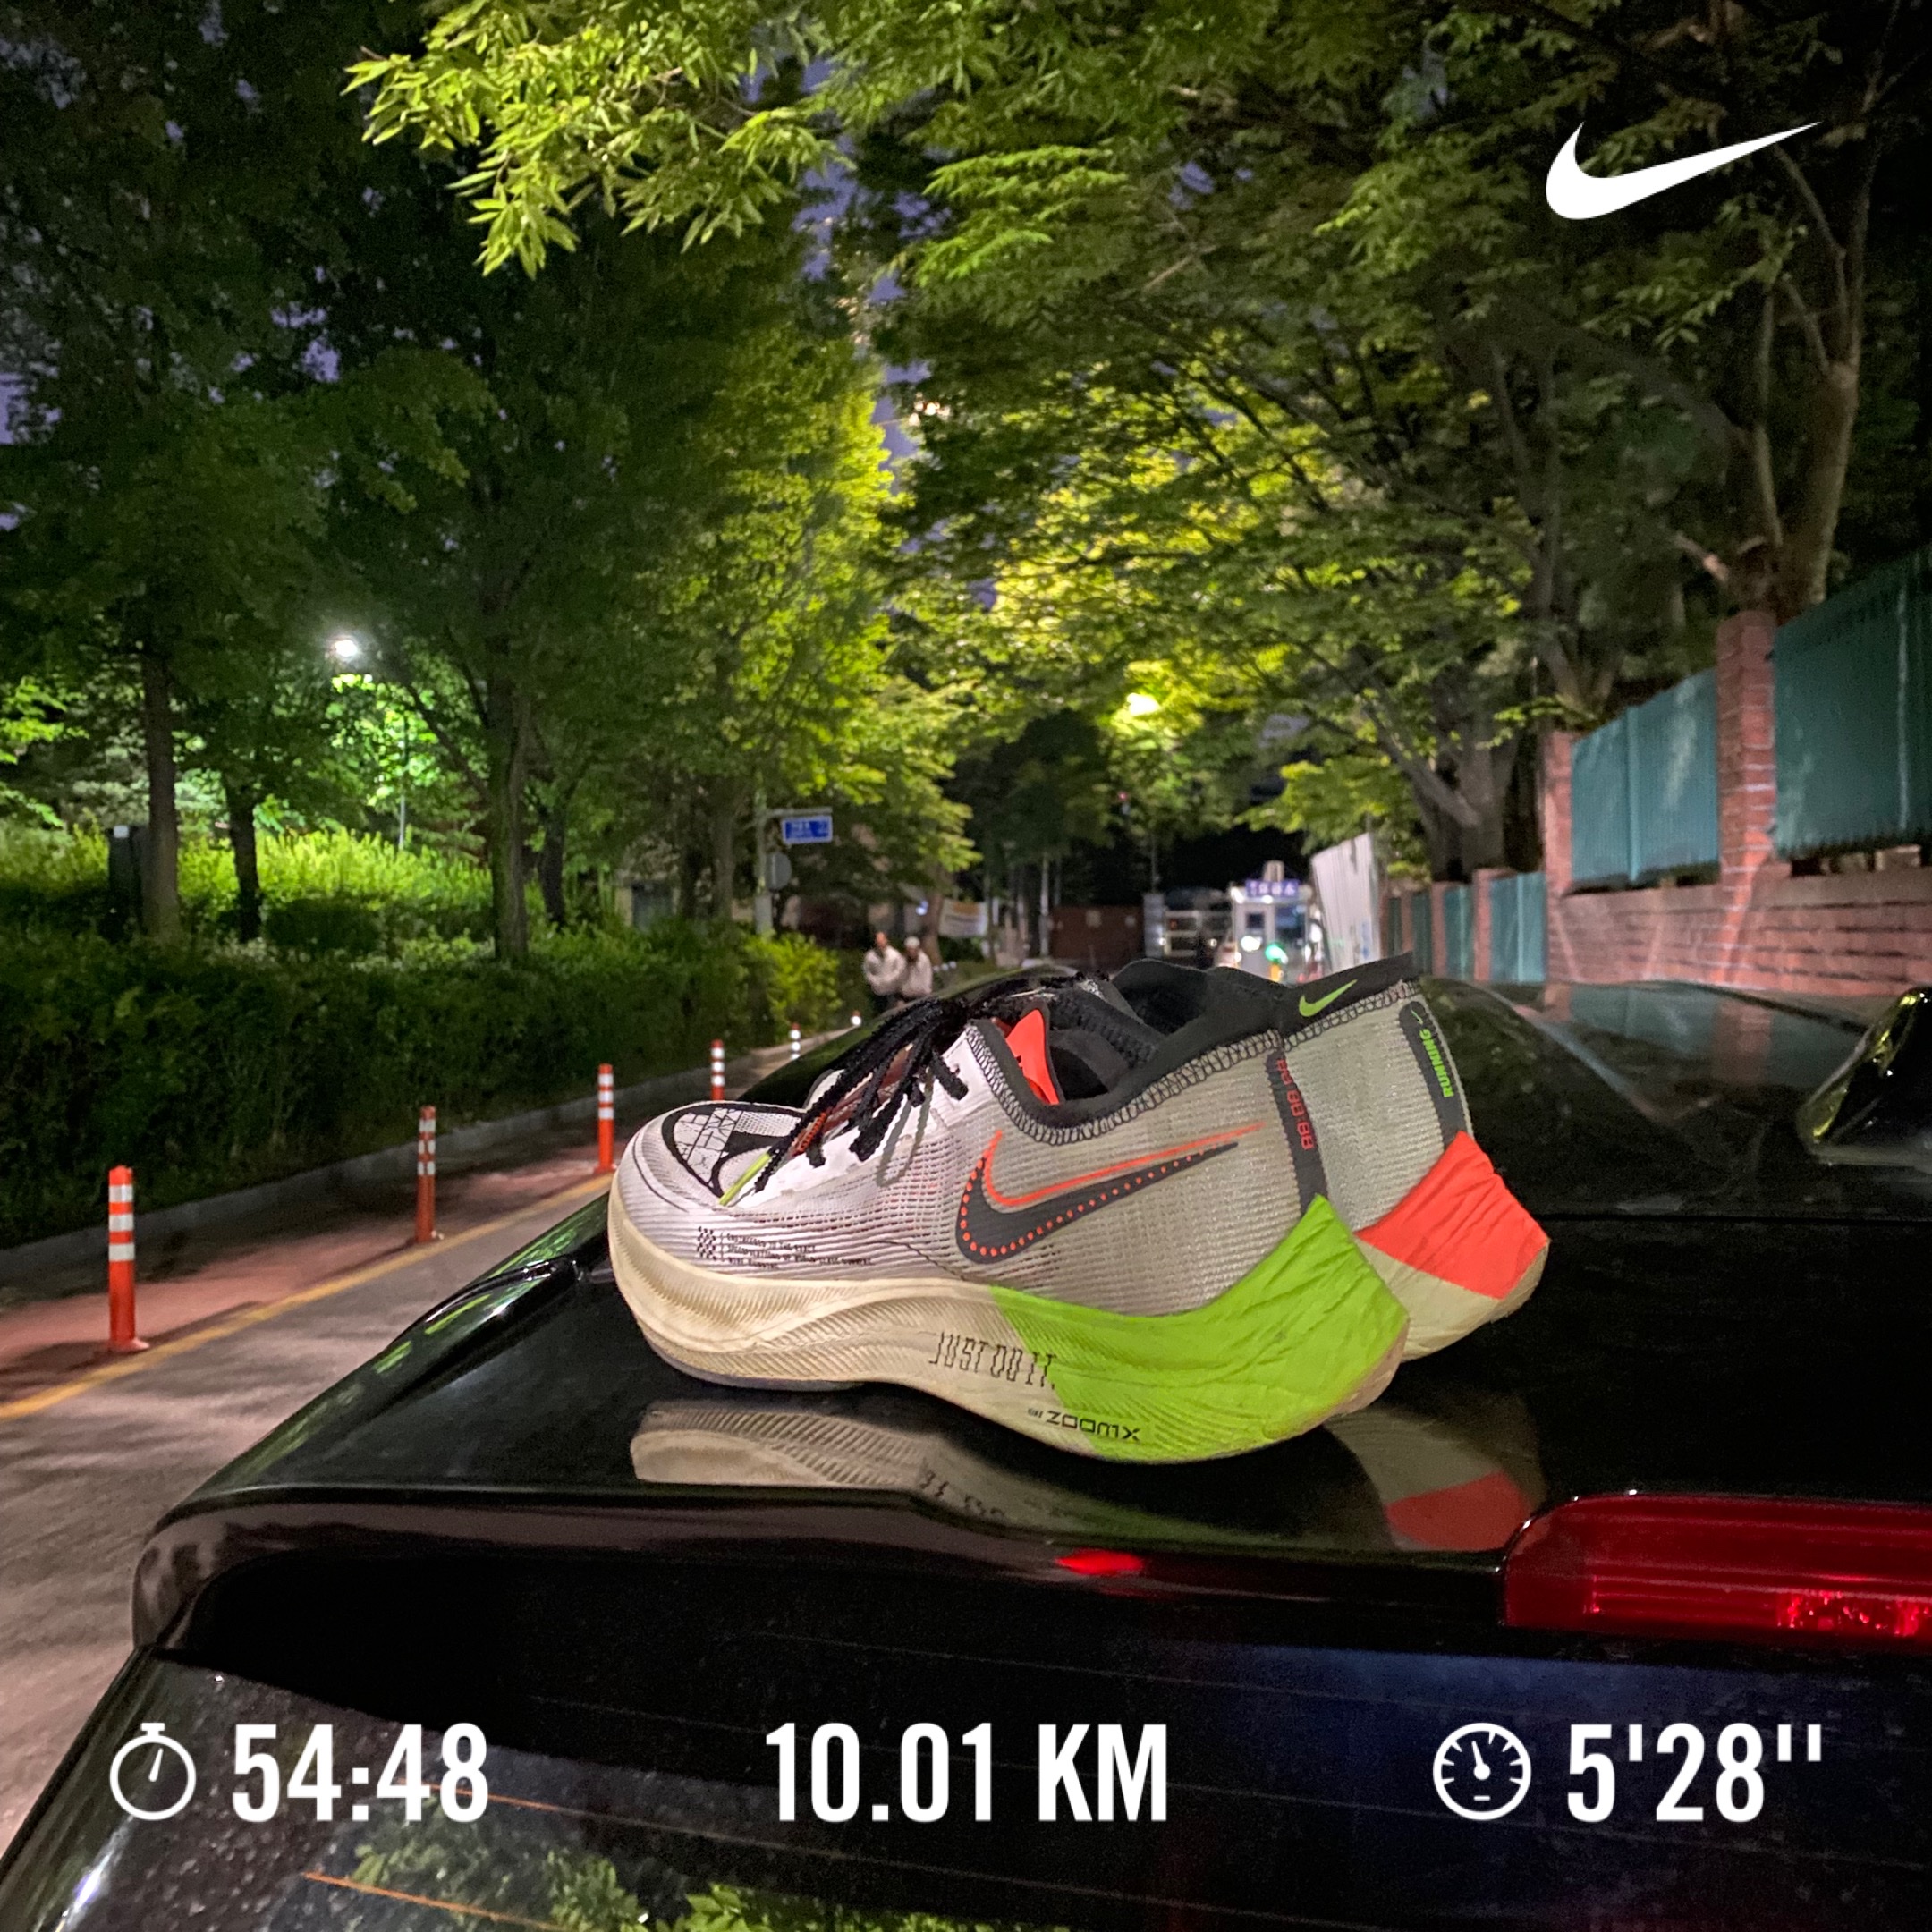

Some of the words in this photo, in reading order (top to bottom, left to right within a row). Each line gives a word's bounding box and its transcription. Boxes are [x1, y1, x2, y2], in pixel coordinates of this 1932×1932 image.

[1419, 1028, 1455, 1098] RUNNING
[928, 1331, 989, 1374] JUST
[989, 1343, 1023, 1382] DO
